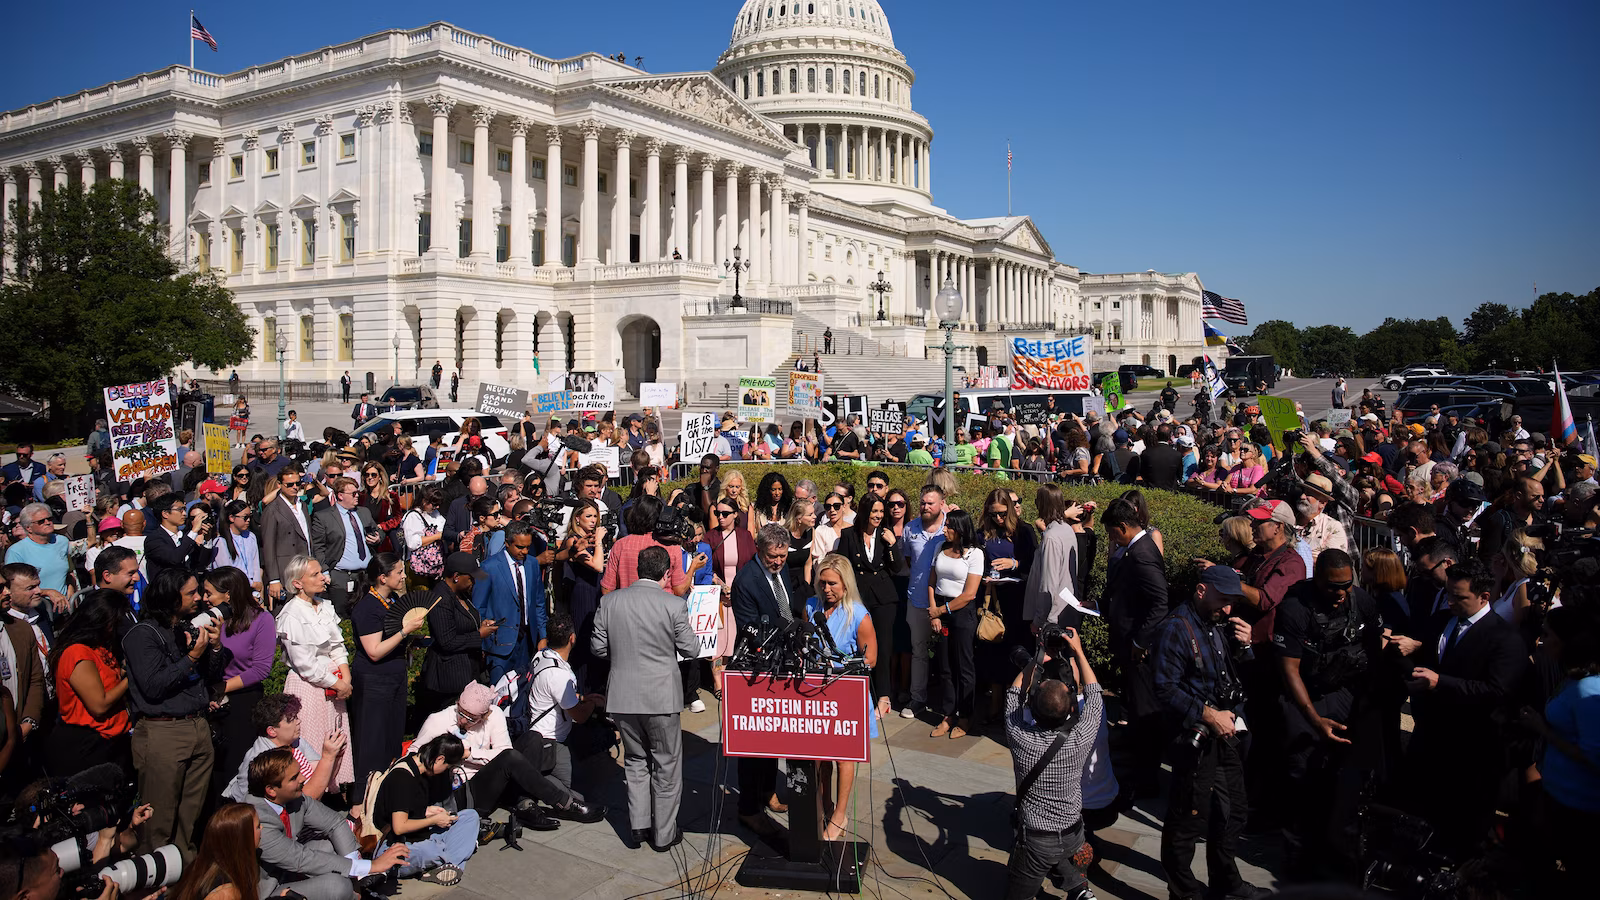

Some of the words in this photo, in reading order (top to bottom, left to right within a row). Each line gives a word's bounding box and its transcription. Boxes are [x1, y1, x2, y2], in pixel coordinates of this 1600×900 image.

[1014, 336, 1084, 362] BELIEVE
[486, 384, 518, 396] NEUTER
[739, 378, 776, 388] FRIENDS
[107, 380, 166, 401] BELIEVE
[537, 390, 572, 404] BELIEVE
[572, 393, 586, 401] ock
[588, 393, 605, 401] the
[122, 396, 150, 409] THE
[483, 394, 513, 404] GRAND
[480, 404, 525, 420] PEDOPHILES
[537, 401, 569, 413] WOMEN
[844, 396, 869, 427] H
[1260, 398, 1295, 415] TRUST
[686, 417, 700, 431] HE
[701, 414, 711, 426] IS
[871, 409, 903, 423] RELEASE
[111, 419, 167, 437] RELEASE
[687, 428, 700, 439] ON
[701, 426, 714, 435] the
[876, 422, 903, 434] FILES
[114, 436, 141, 449] THE
[684, 436, 714, 457] LIST!
[207, 449, 231, 461] MATTER
[118, 452, 177, 475] CHILDREN
[67, 482, 88, 495] FREE
[747, 625, 758, 637] svt
[751, 698, 802, 715] EPSTEIN
[805, 700, 839, 717] FILES
[732, 715, 831, 735] TRANSPARENCY
[833, 720, 859, 736] ACT
